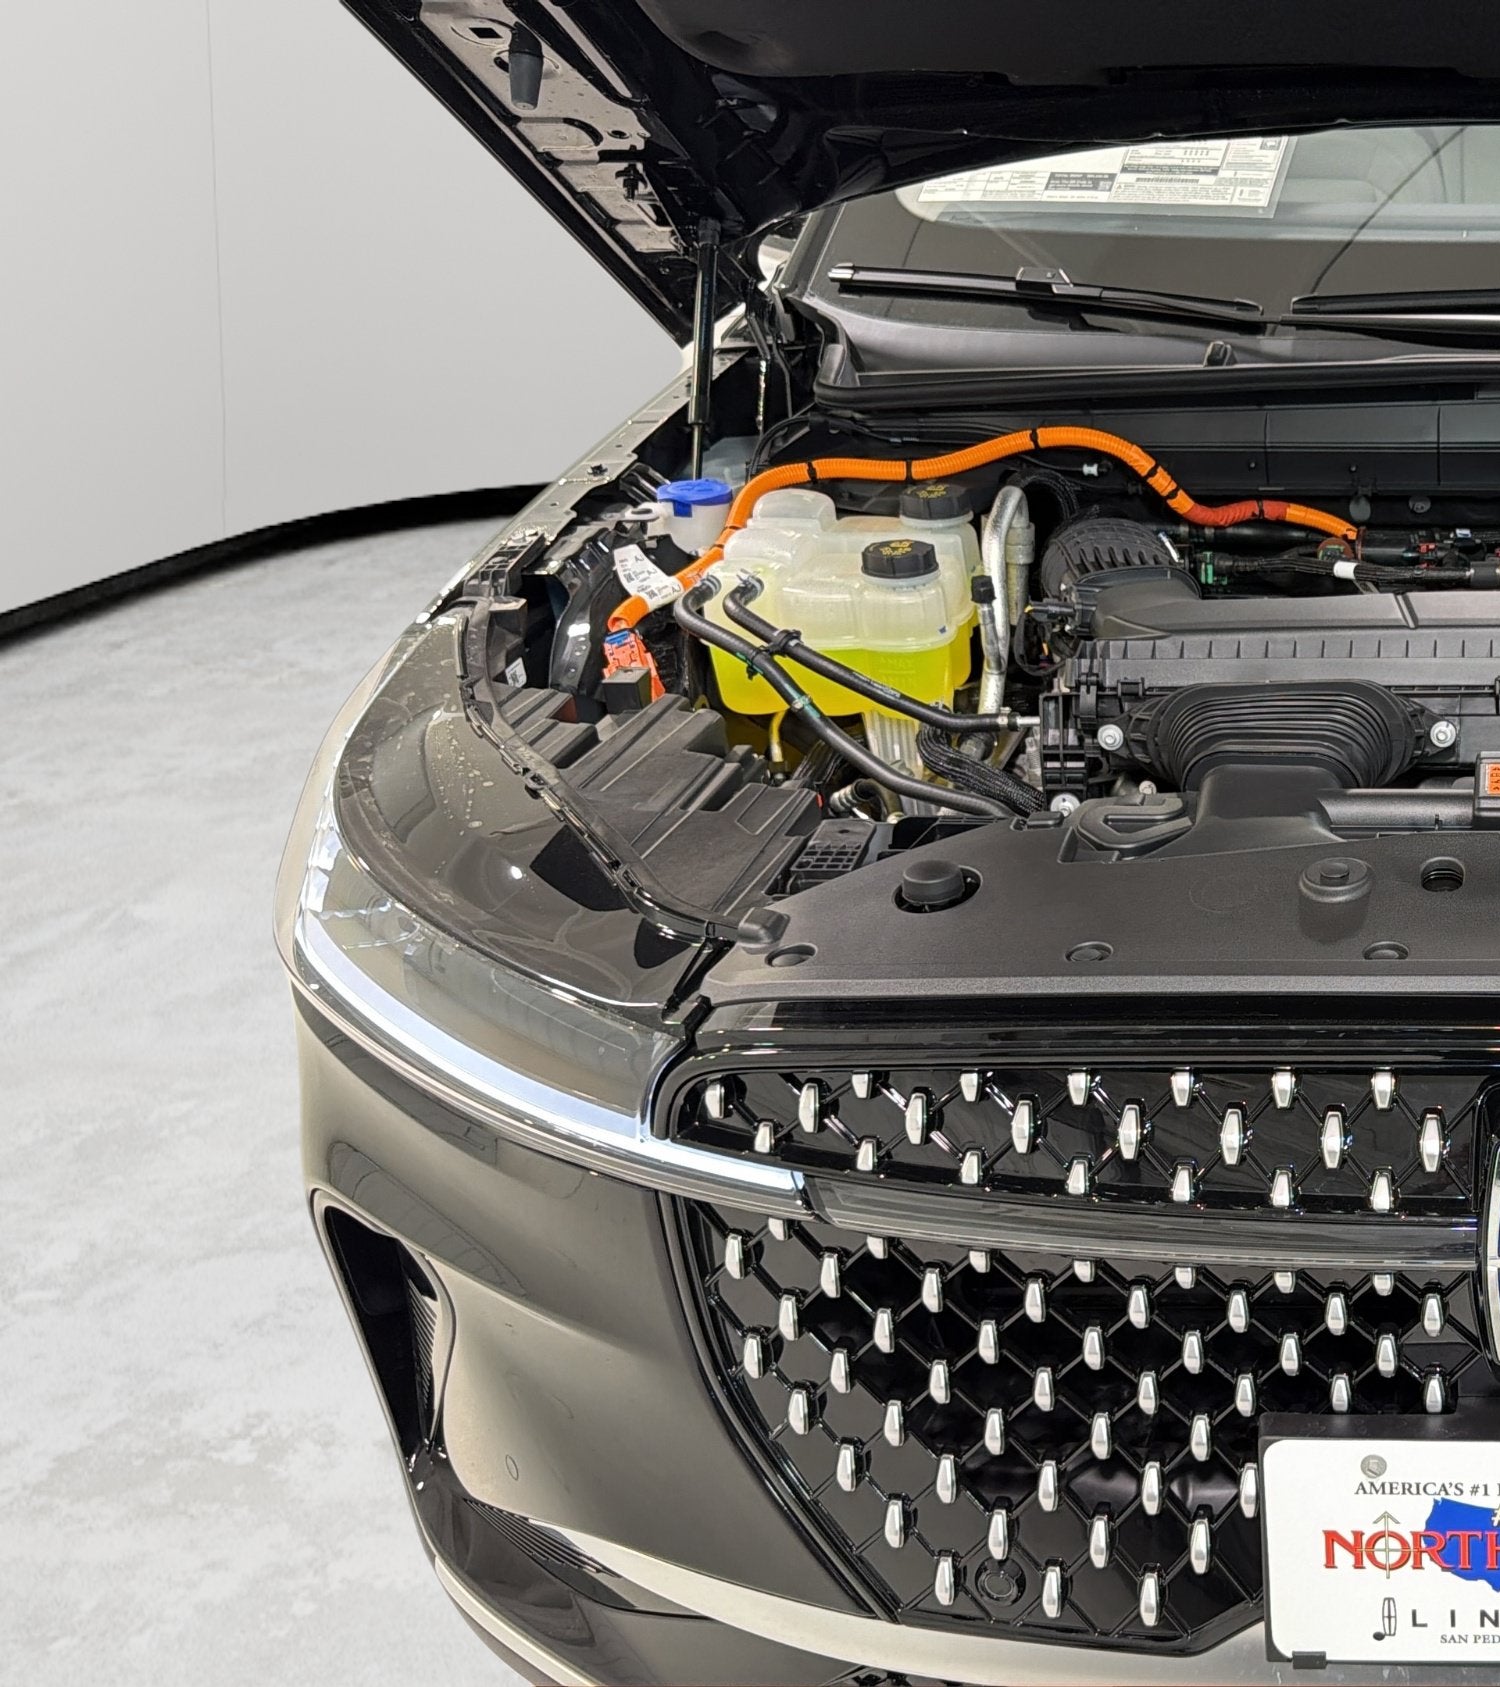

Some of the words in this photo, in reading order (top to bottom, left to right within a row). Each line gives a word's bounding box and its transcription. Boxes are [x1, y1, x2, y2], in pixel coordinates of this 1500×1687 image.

[1354, 1481, 1465, 1497] AMERICA'S
[1469, 1483, 1490, 1497] #1
[1440, 1634, 1469, 1645] SAN
